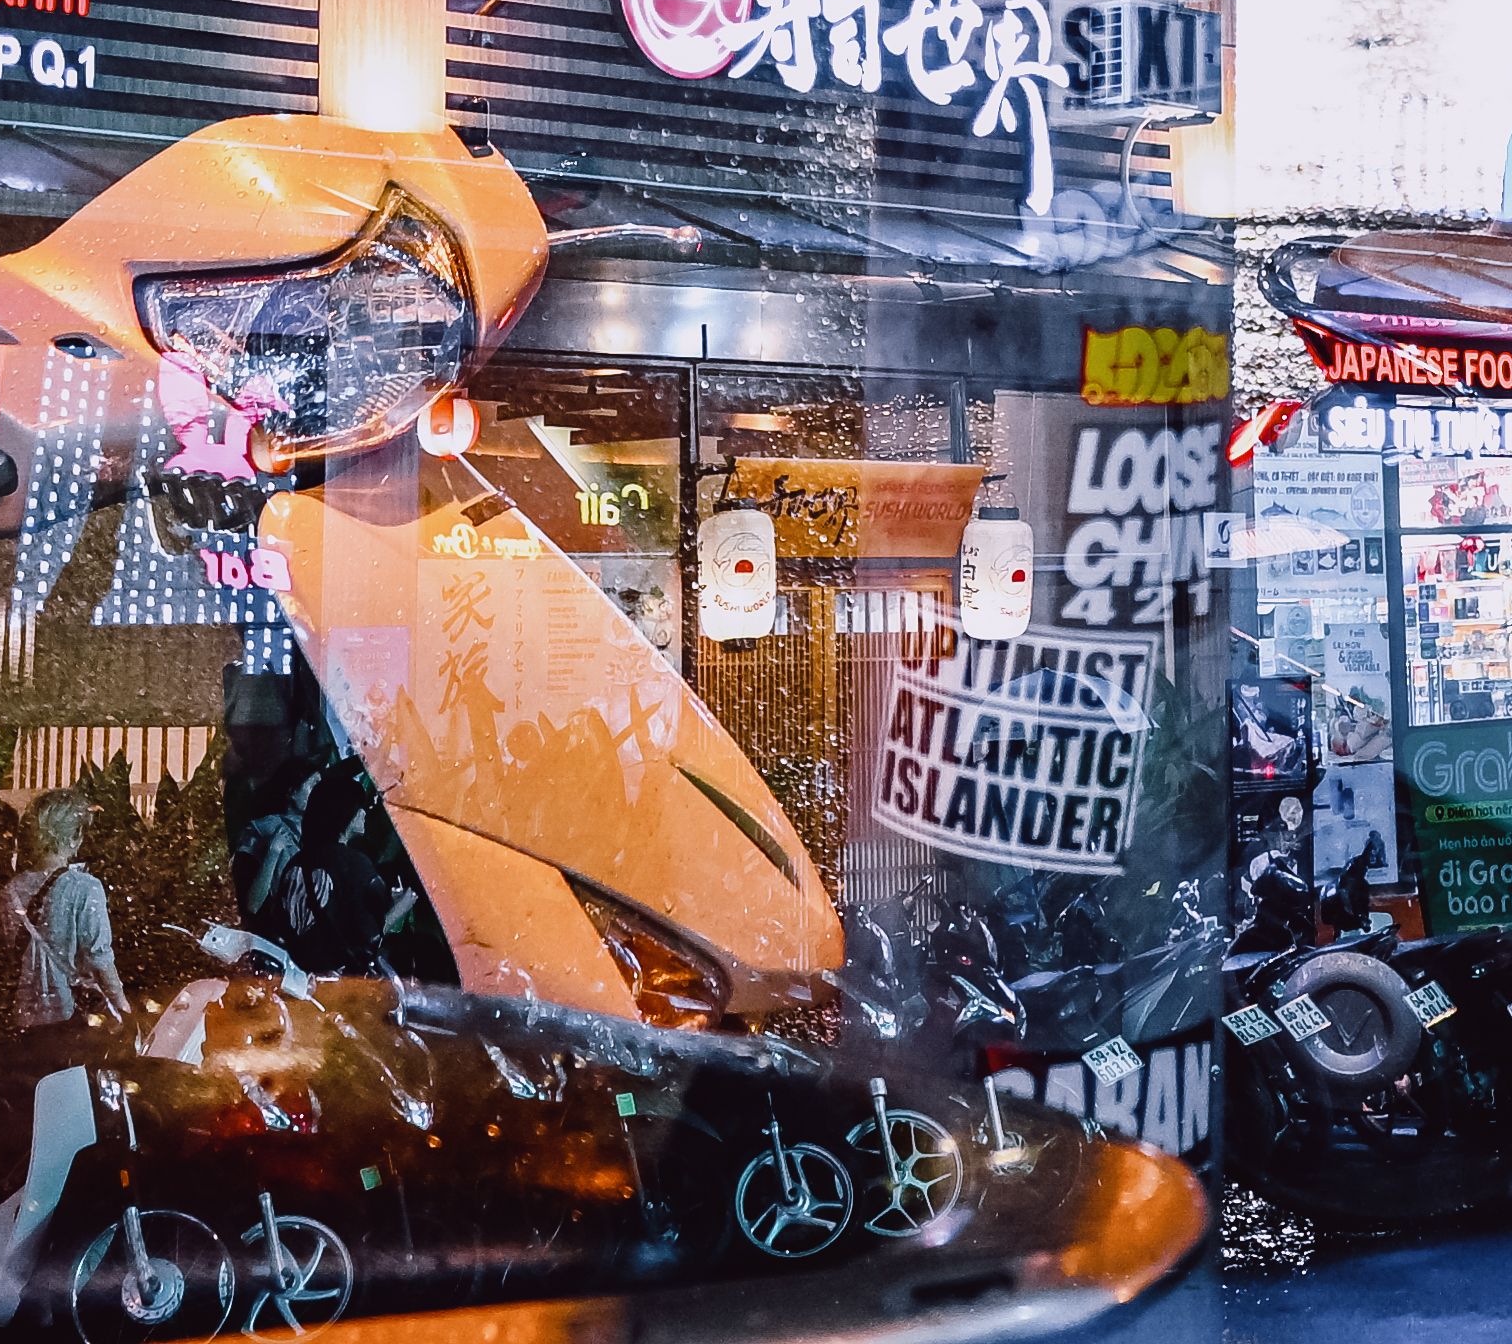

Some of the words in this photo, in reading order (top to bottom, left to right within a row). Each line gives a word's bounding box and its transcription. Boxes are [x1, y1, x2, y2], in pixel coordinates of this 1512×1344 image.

[29, 39, 97, 89] Q.1
[1328, 342, 1458, 387] JAPANESE
[888, 687, 1133, 789] ATLANTIC
[880, 750, 1123, 853] ISLANDER
[1439, 860, 1463, 888] đi
[1447, 890, 1495, 916] bao
